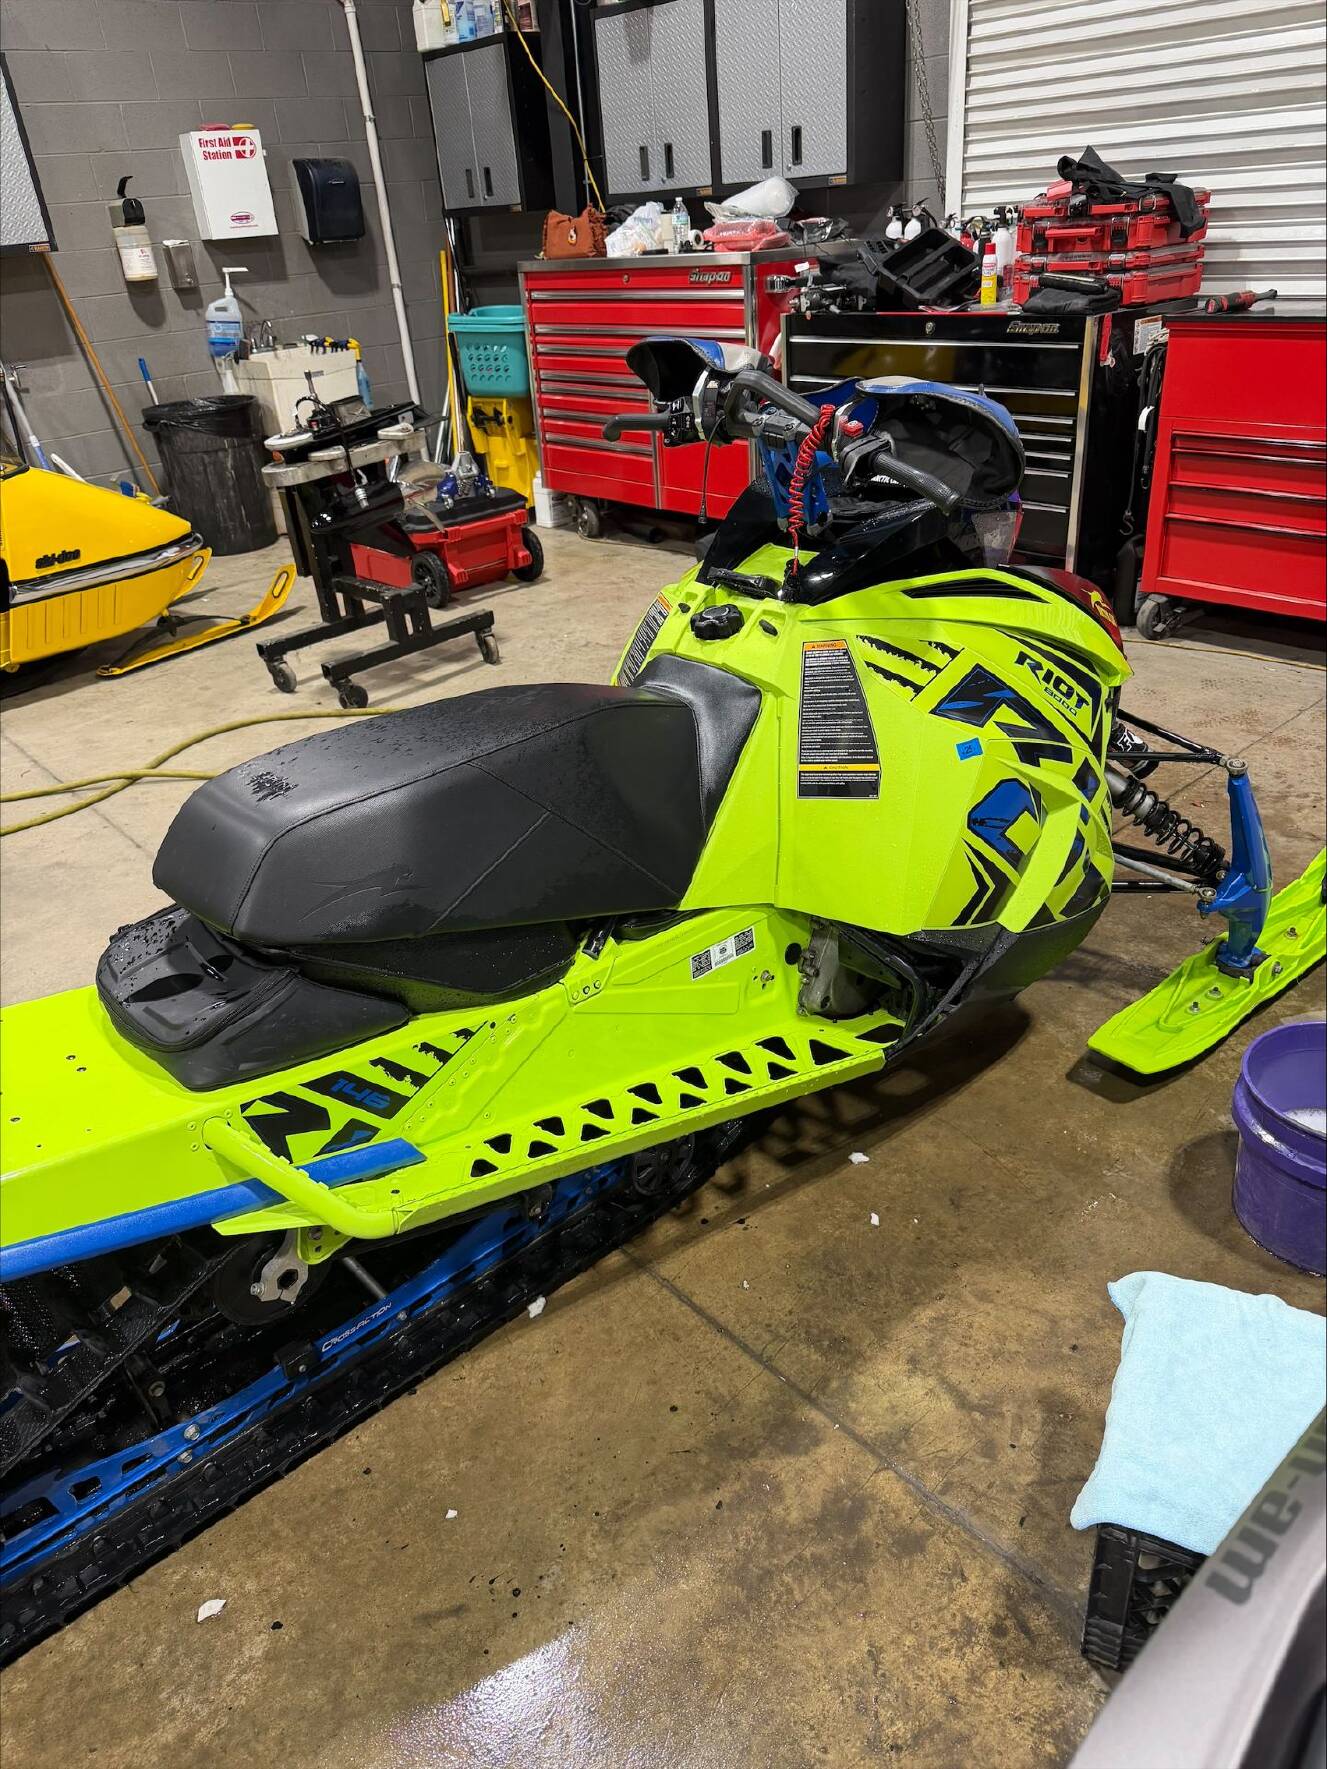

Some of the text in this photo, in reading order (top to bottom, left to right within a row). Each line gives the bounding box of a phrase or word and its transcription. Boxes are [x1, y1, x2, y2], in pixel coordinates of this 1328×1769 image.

[198, 136, 232, 149] First Aid
[202, 150, 233, 161] Station
[1014, 650, 1090, 710] RIOT
[330, 1078, 391, 1111] 146
